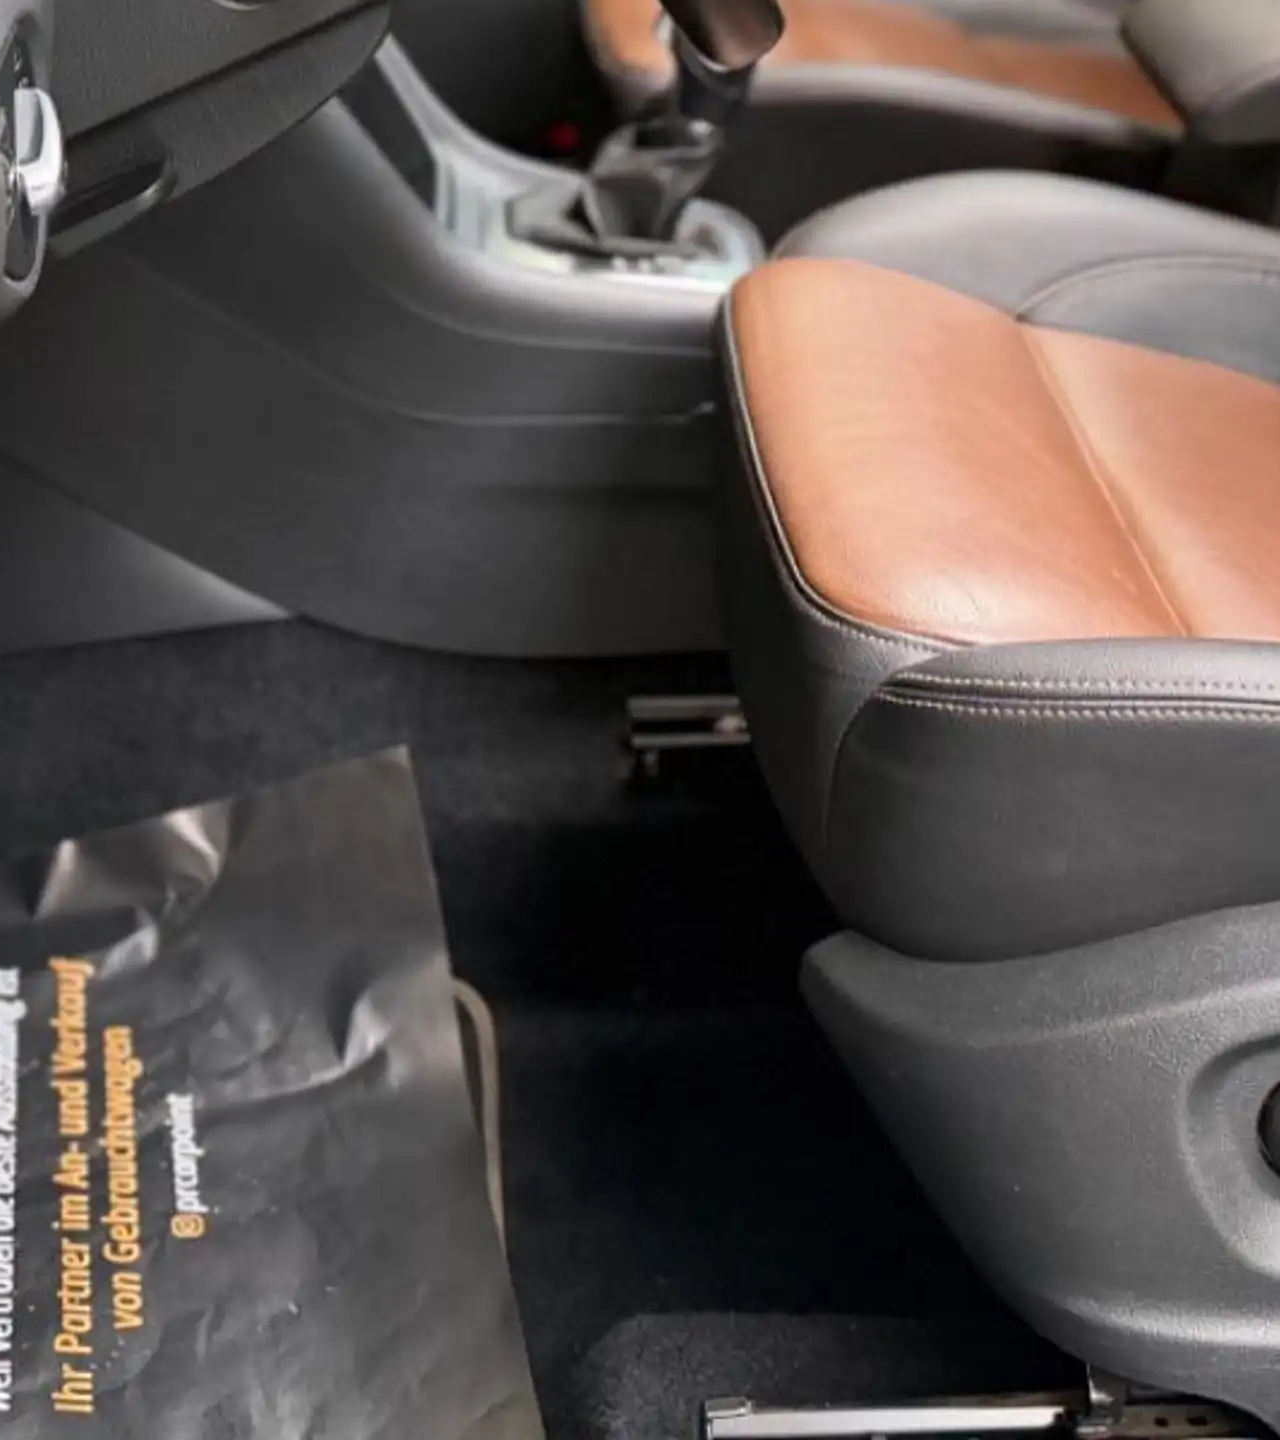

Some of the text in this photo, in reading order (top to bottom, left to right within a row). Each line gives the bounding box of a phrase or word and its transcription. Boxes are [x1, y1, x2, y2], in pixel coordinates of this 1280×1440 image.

[50, 956, 95, 1414] Ihr Partner im An- und Verkauf
[98, 1026, 145, 1329] von Gebrauchtwagen
[167, 1093, 209, 1239] @prcarpoint
